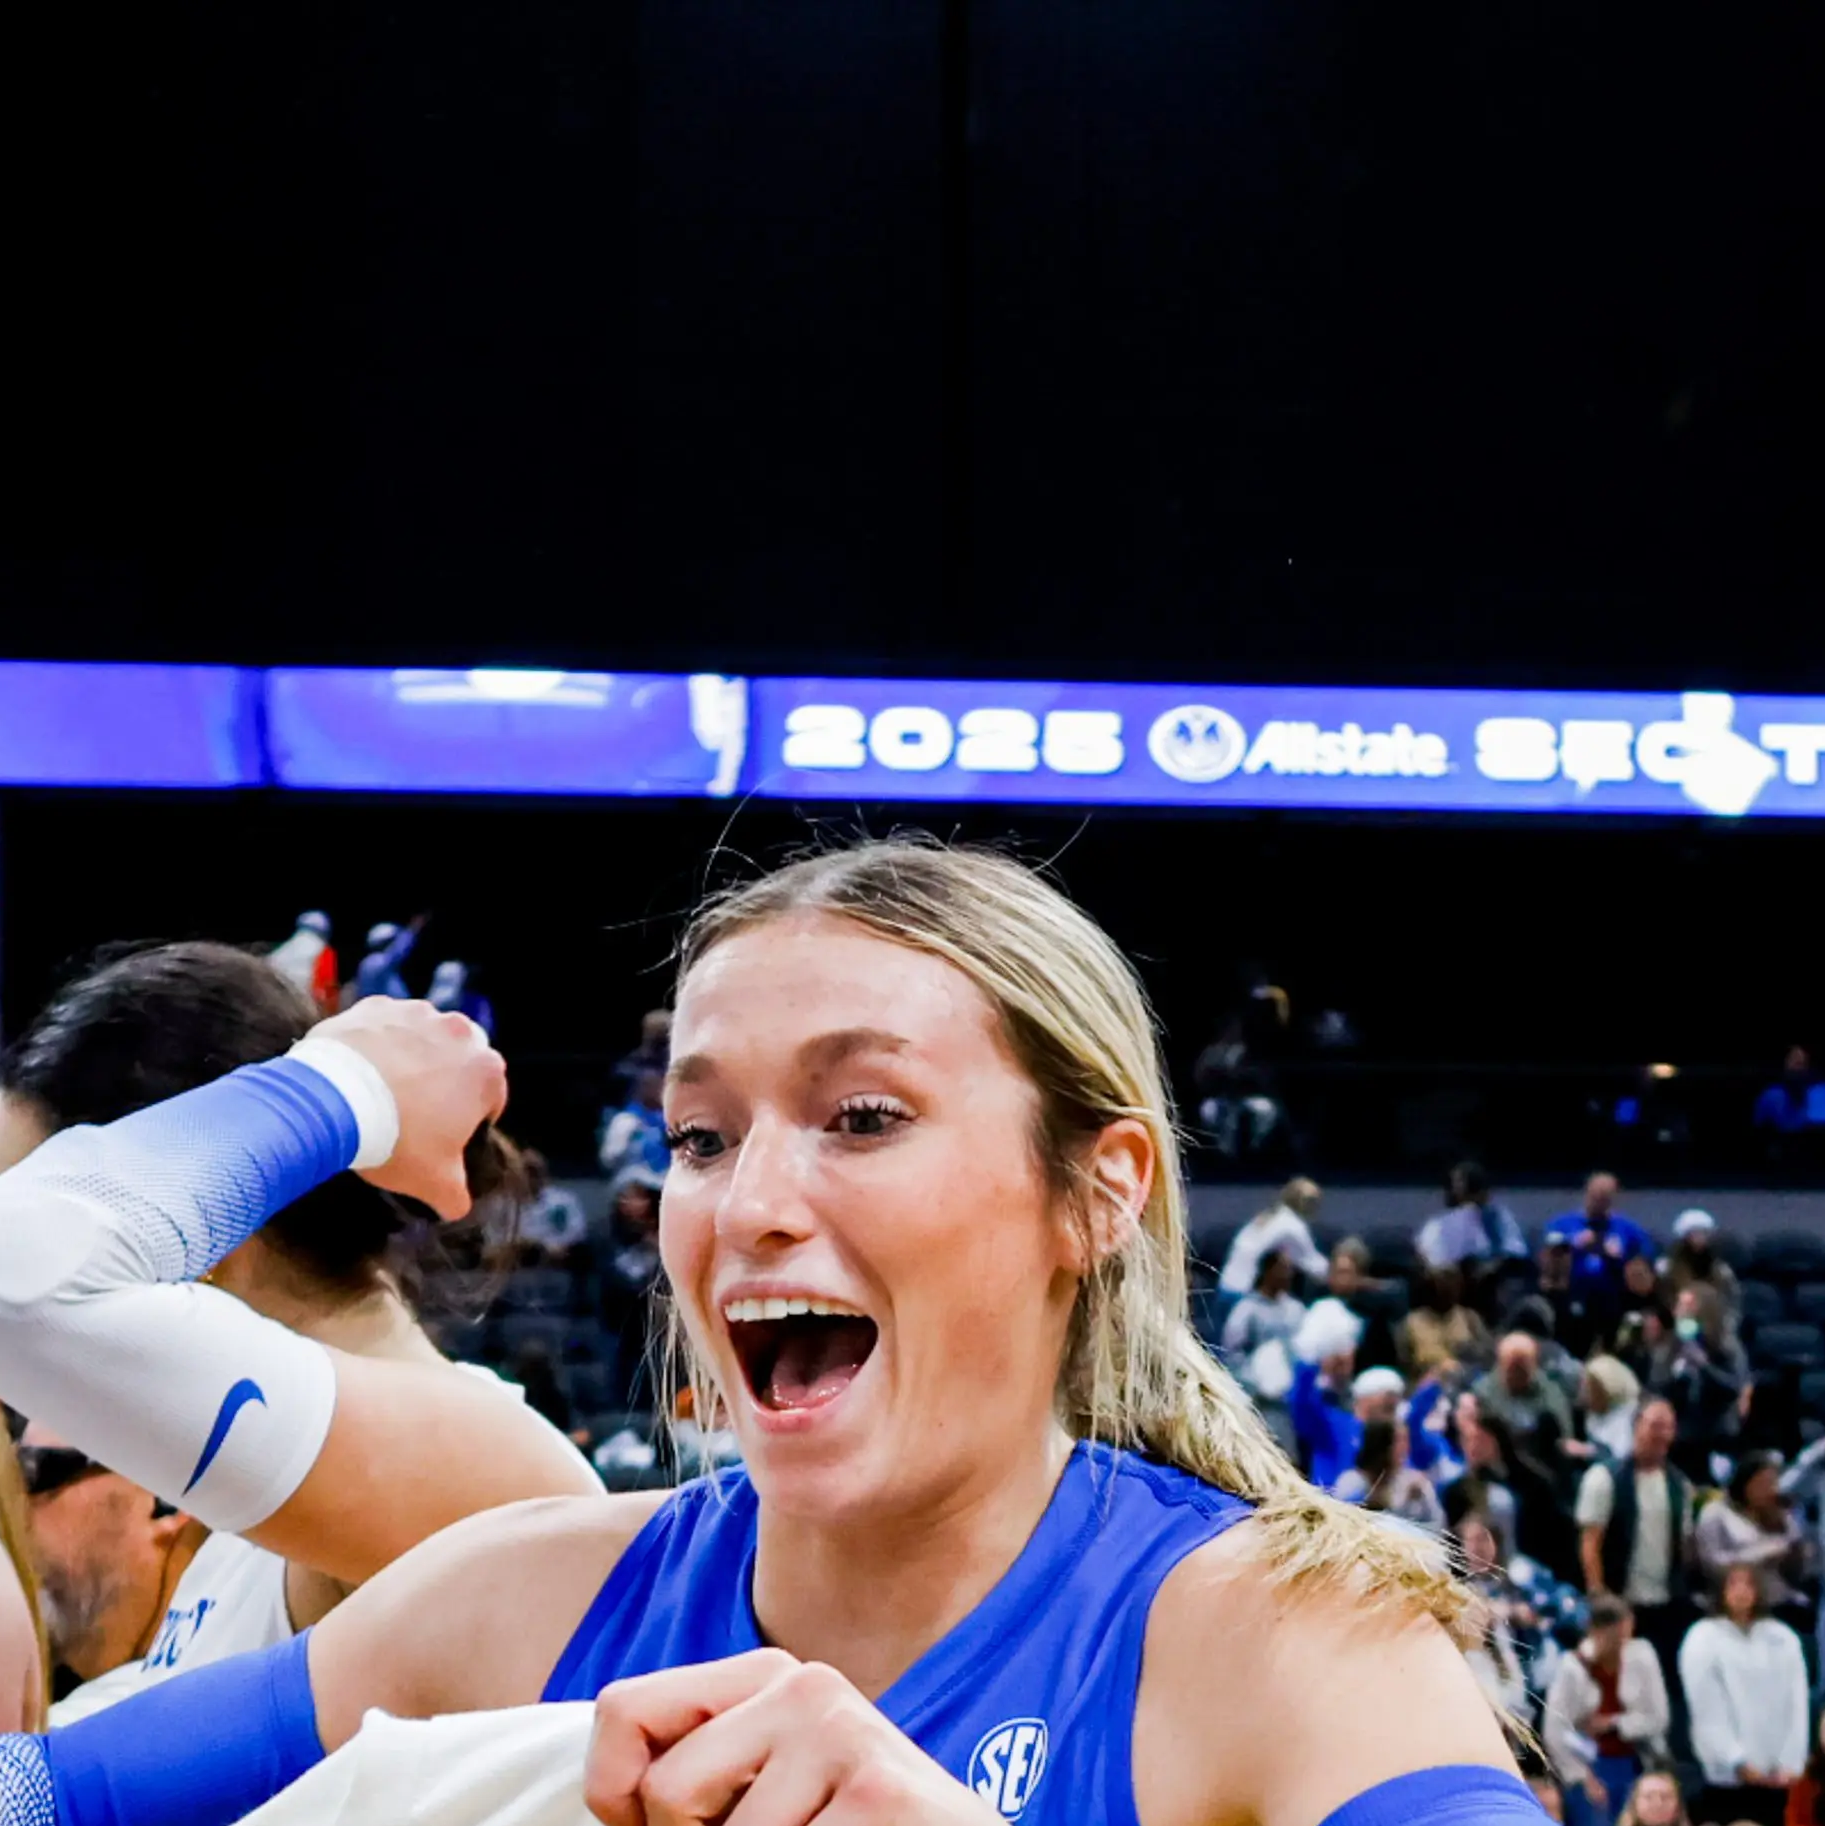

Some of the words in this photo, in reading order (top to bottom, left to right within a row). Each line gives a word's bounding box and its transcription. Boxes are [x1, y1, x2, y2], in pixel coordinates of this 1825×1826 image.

[782, 704, 1125, 774] 2025
[1242, 720, 1451, 778] Allstate
[1475, 716, 1734, 786] SEC
